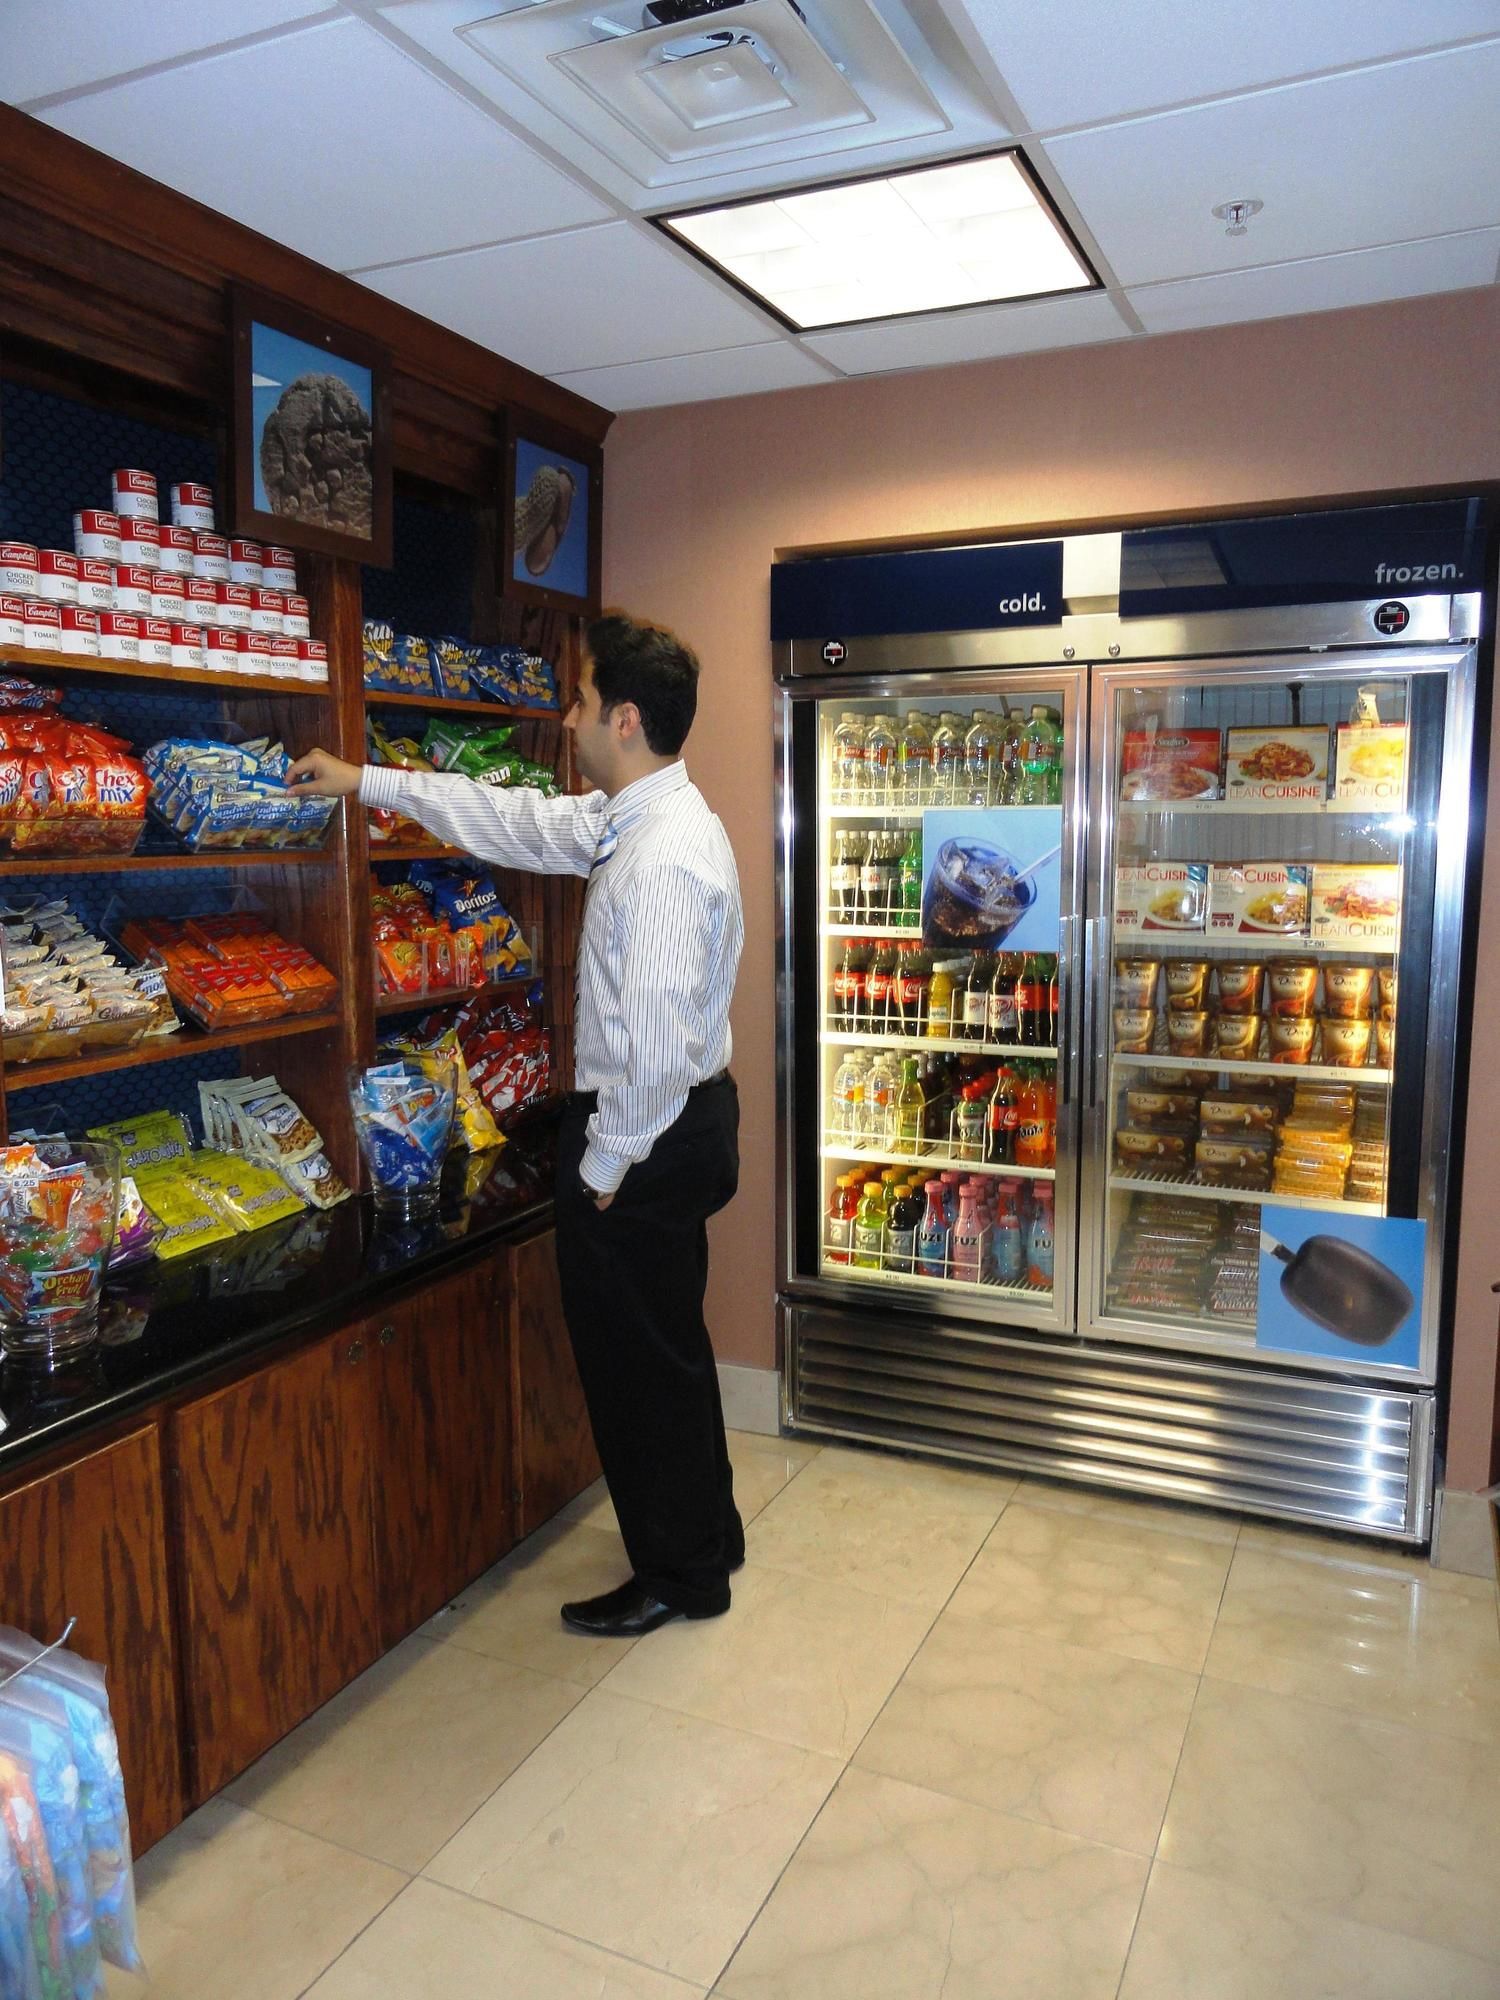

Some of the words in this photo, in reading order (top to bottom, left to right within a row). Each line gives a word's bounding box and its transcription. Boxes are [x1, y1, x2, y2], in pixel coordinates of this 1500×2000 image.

[1375, 562, 1464, 584] frozen.
[999, 592, 1046, 614] cold.
[101, 787, 136, 805] mix
[453, 889, 498, 913] Doritos
